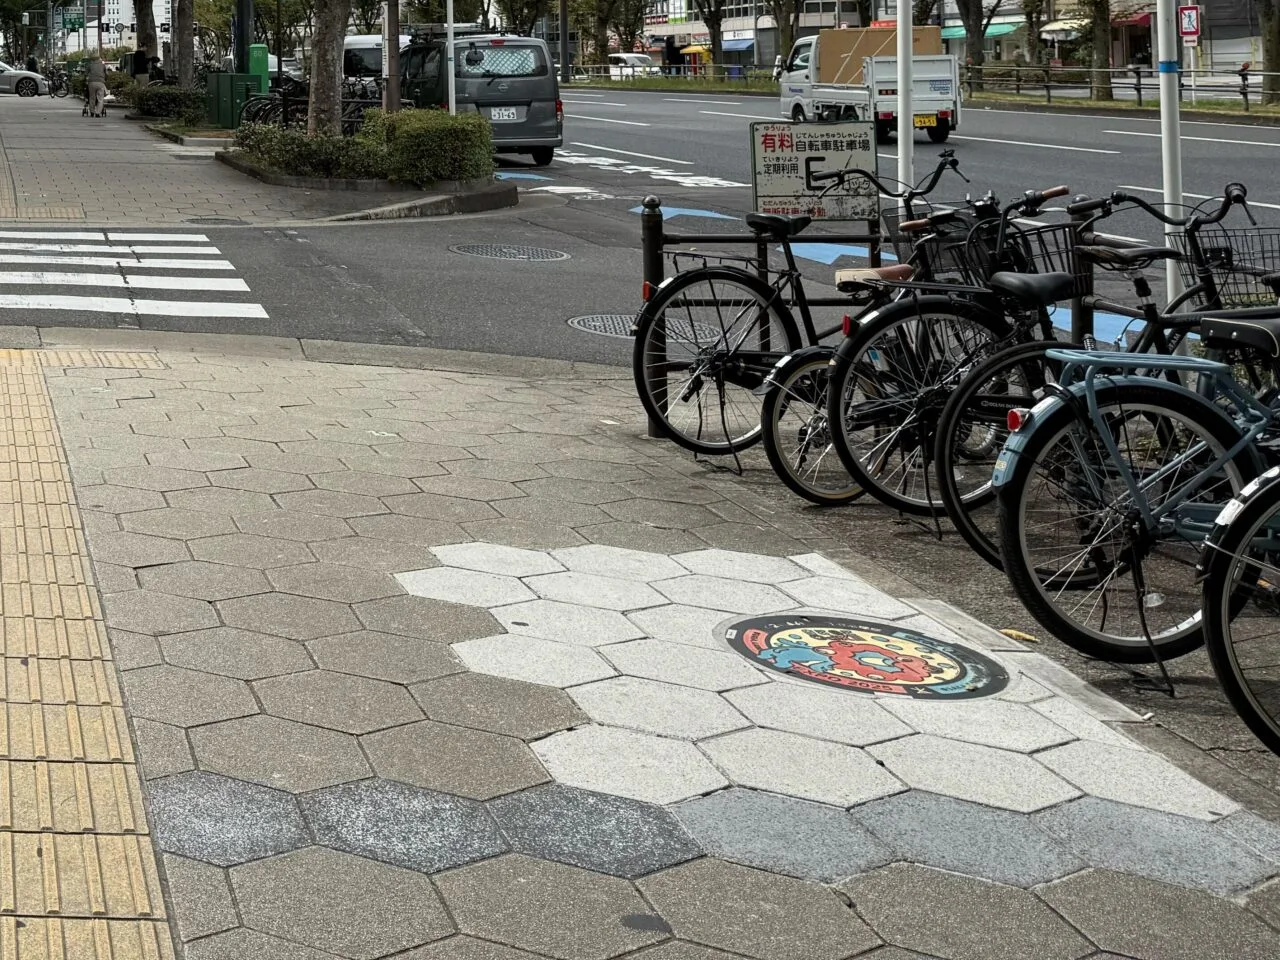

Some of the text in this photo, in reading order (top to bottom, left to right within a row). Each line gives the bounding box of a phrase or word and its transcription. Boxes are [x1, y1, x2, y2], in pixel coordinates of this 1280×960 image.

[761, 133, 870, 153] 有料 自転車駐車場
[763, 163, 799, 175] 定期利用
[847, 680, 894, 691] 2025
